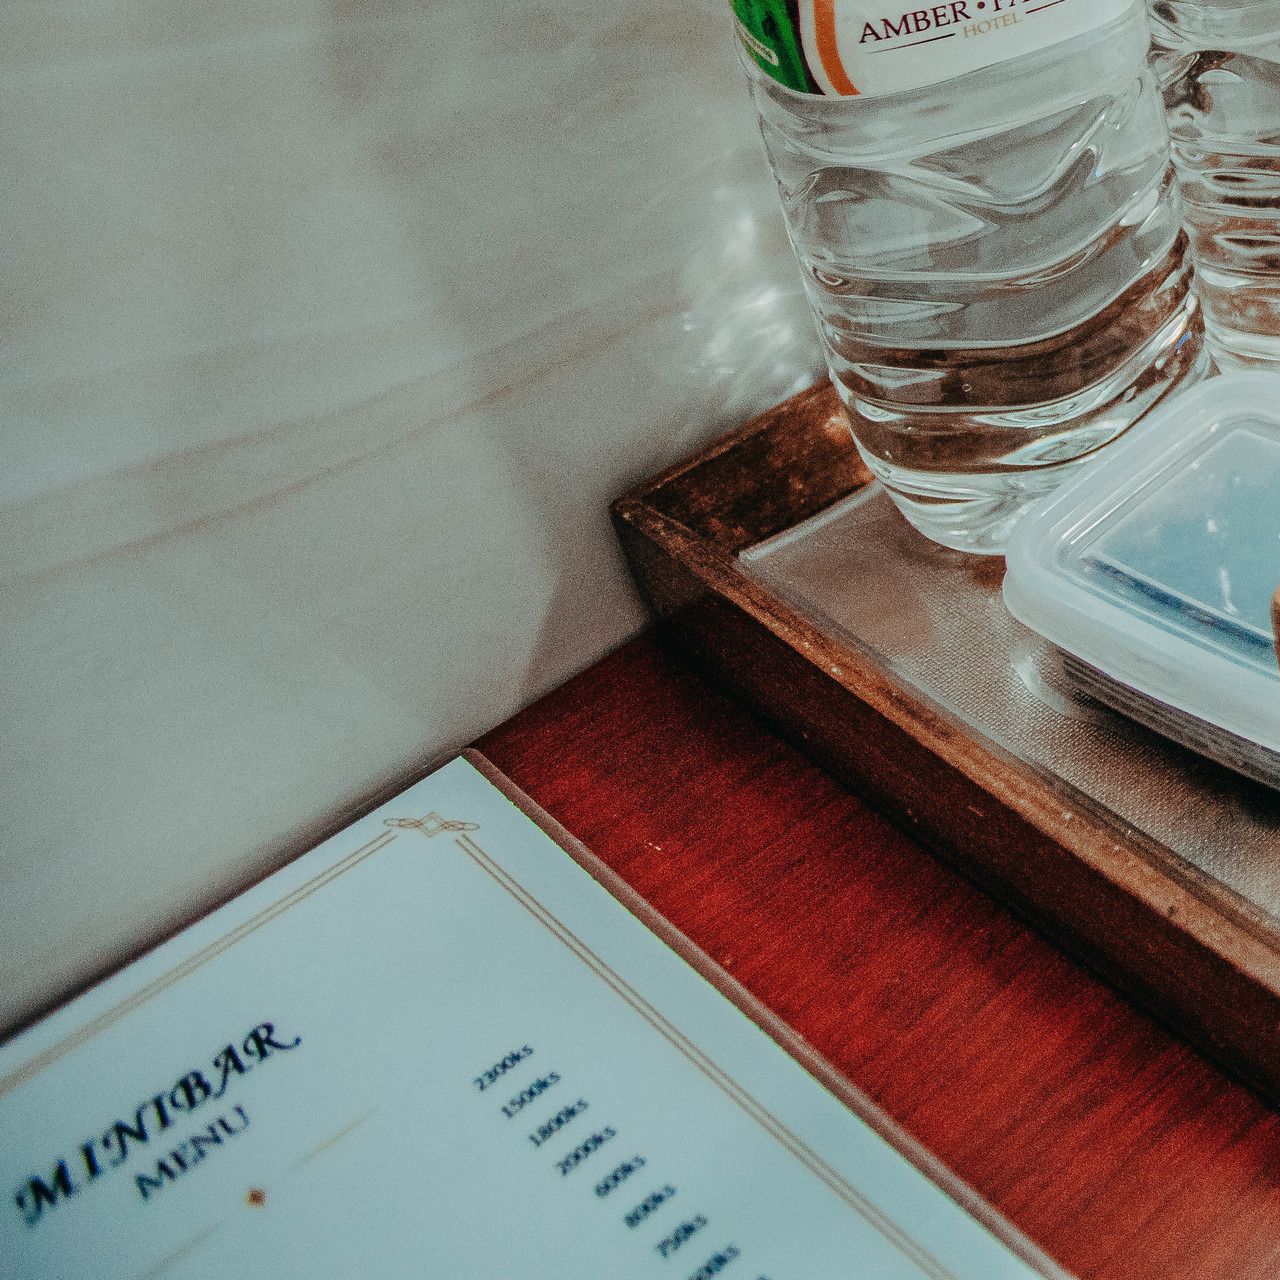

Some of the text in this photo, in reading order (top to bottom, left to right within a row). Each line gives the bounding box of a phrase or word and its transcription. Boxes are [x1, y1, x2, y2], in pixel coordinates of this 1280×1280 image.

[858, 0, 970, 44] AMBER
[962, 12, 1023, 40] HOTEL
[14, 1021, 302, 1228] MINIBAR
[134, 1102, 251, 1200] MENU
